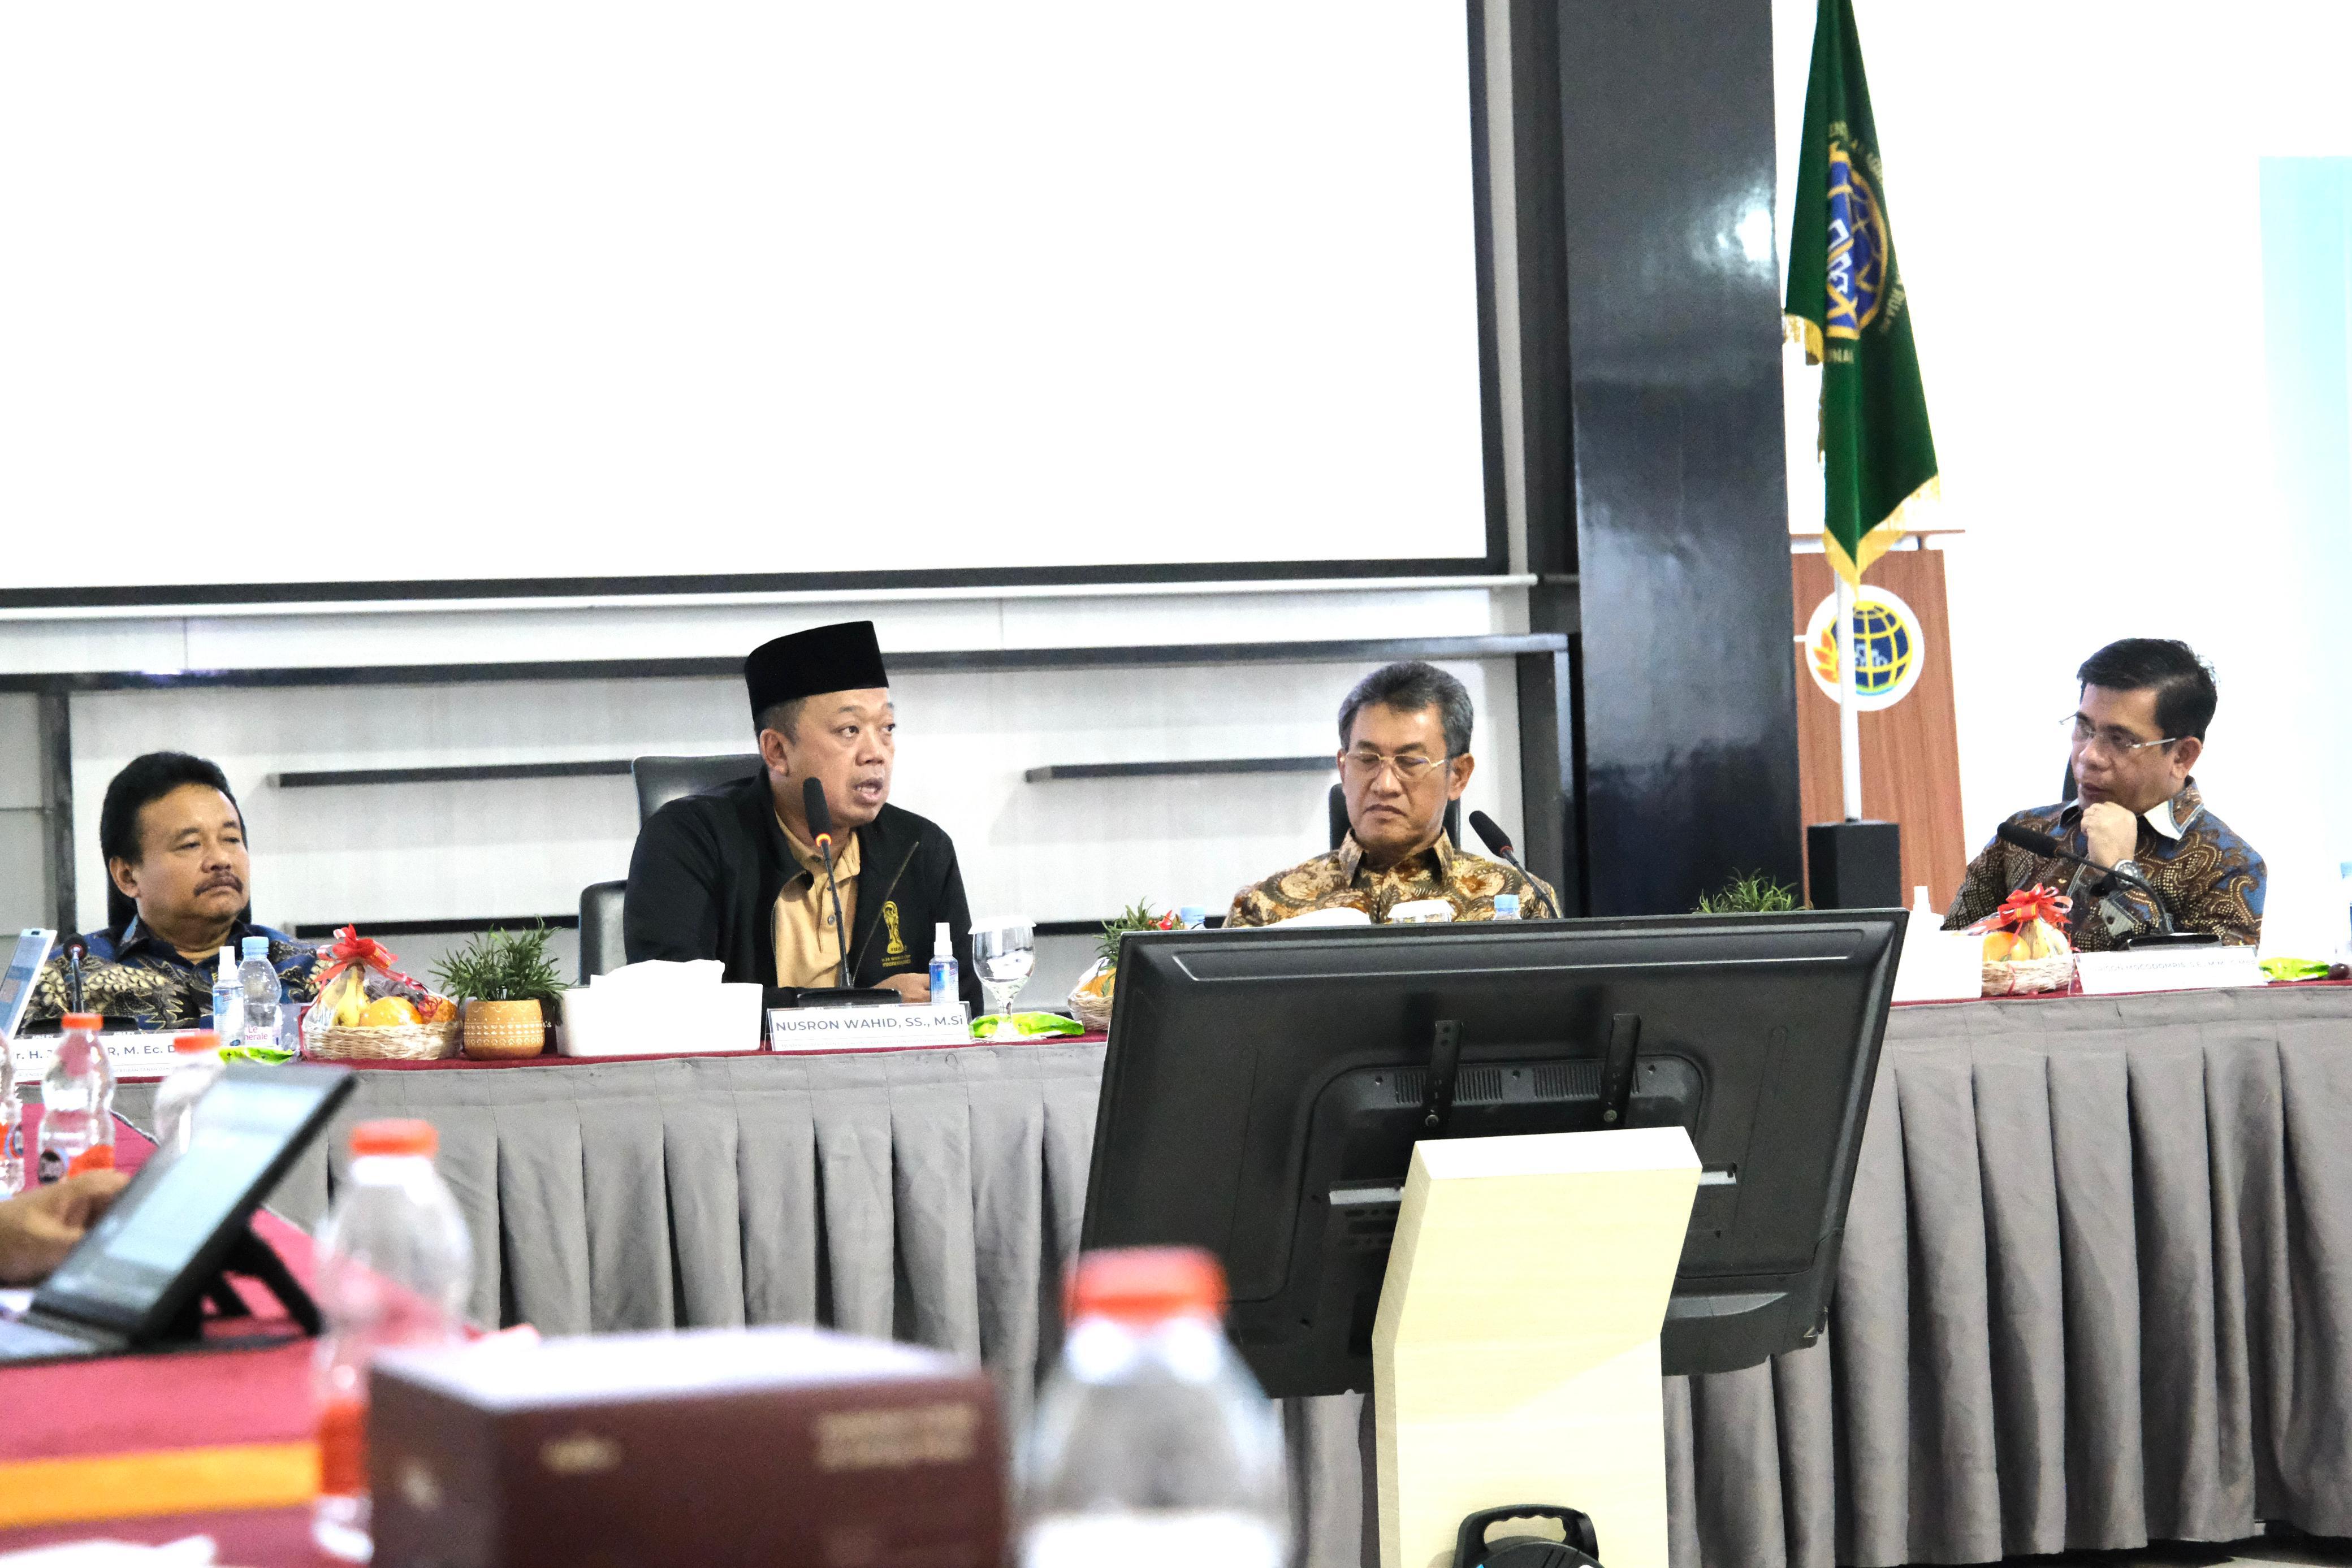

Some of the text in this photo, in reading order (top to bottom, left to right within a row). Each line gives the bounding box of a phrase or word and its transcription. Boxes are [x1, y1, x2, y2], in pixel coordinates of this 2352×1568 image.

[248, 1025, 258, 1033] Le
[776, 1015, 963, 1032] NUSRON WAHID, SS., M.Si
[29, 1050, 42, 1059] H.
[124, 1046, 140, 1055] M.
[144, 1045, 163, 1054] Ec.
